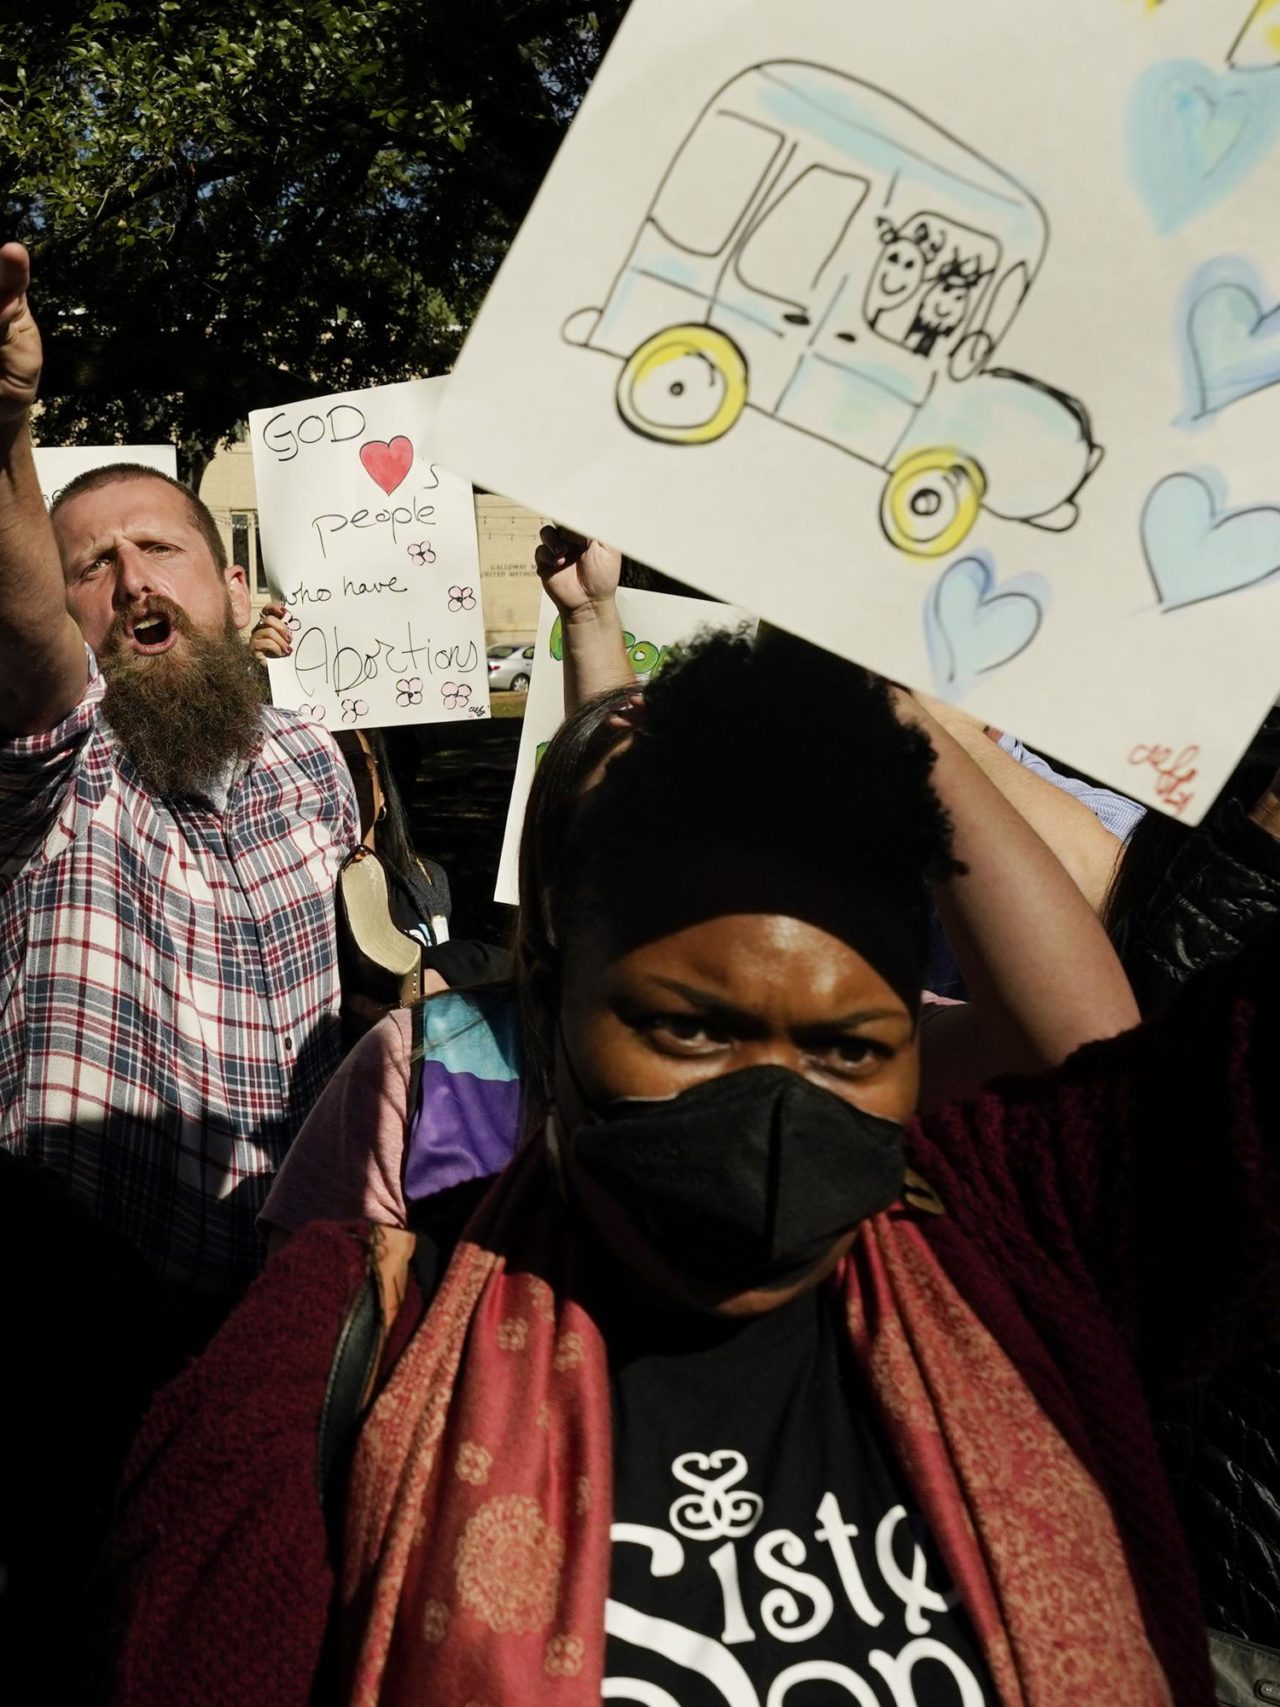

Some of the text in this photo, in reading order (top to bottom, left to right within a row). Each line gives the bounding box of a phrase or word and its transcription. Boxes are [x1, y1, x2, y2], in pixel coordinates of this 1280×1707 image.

[263, 405, 366, 461] GOD
[312, 496, 437, 558] people
[343, 575, 408, 597] have
[294, 621, 479, 698] Abortions
